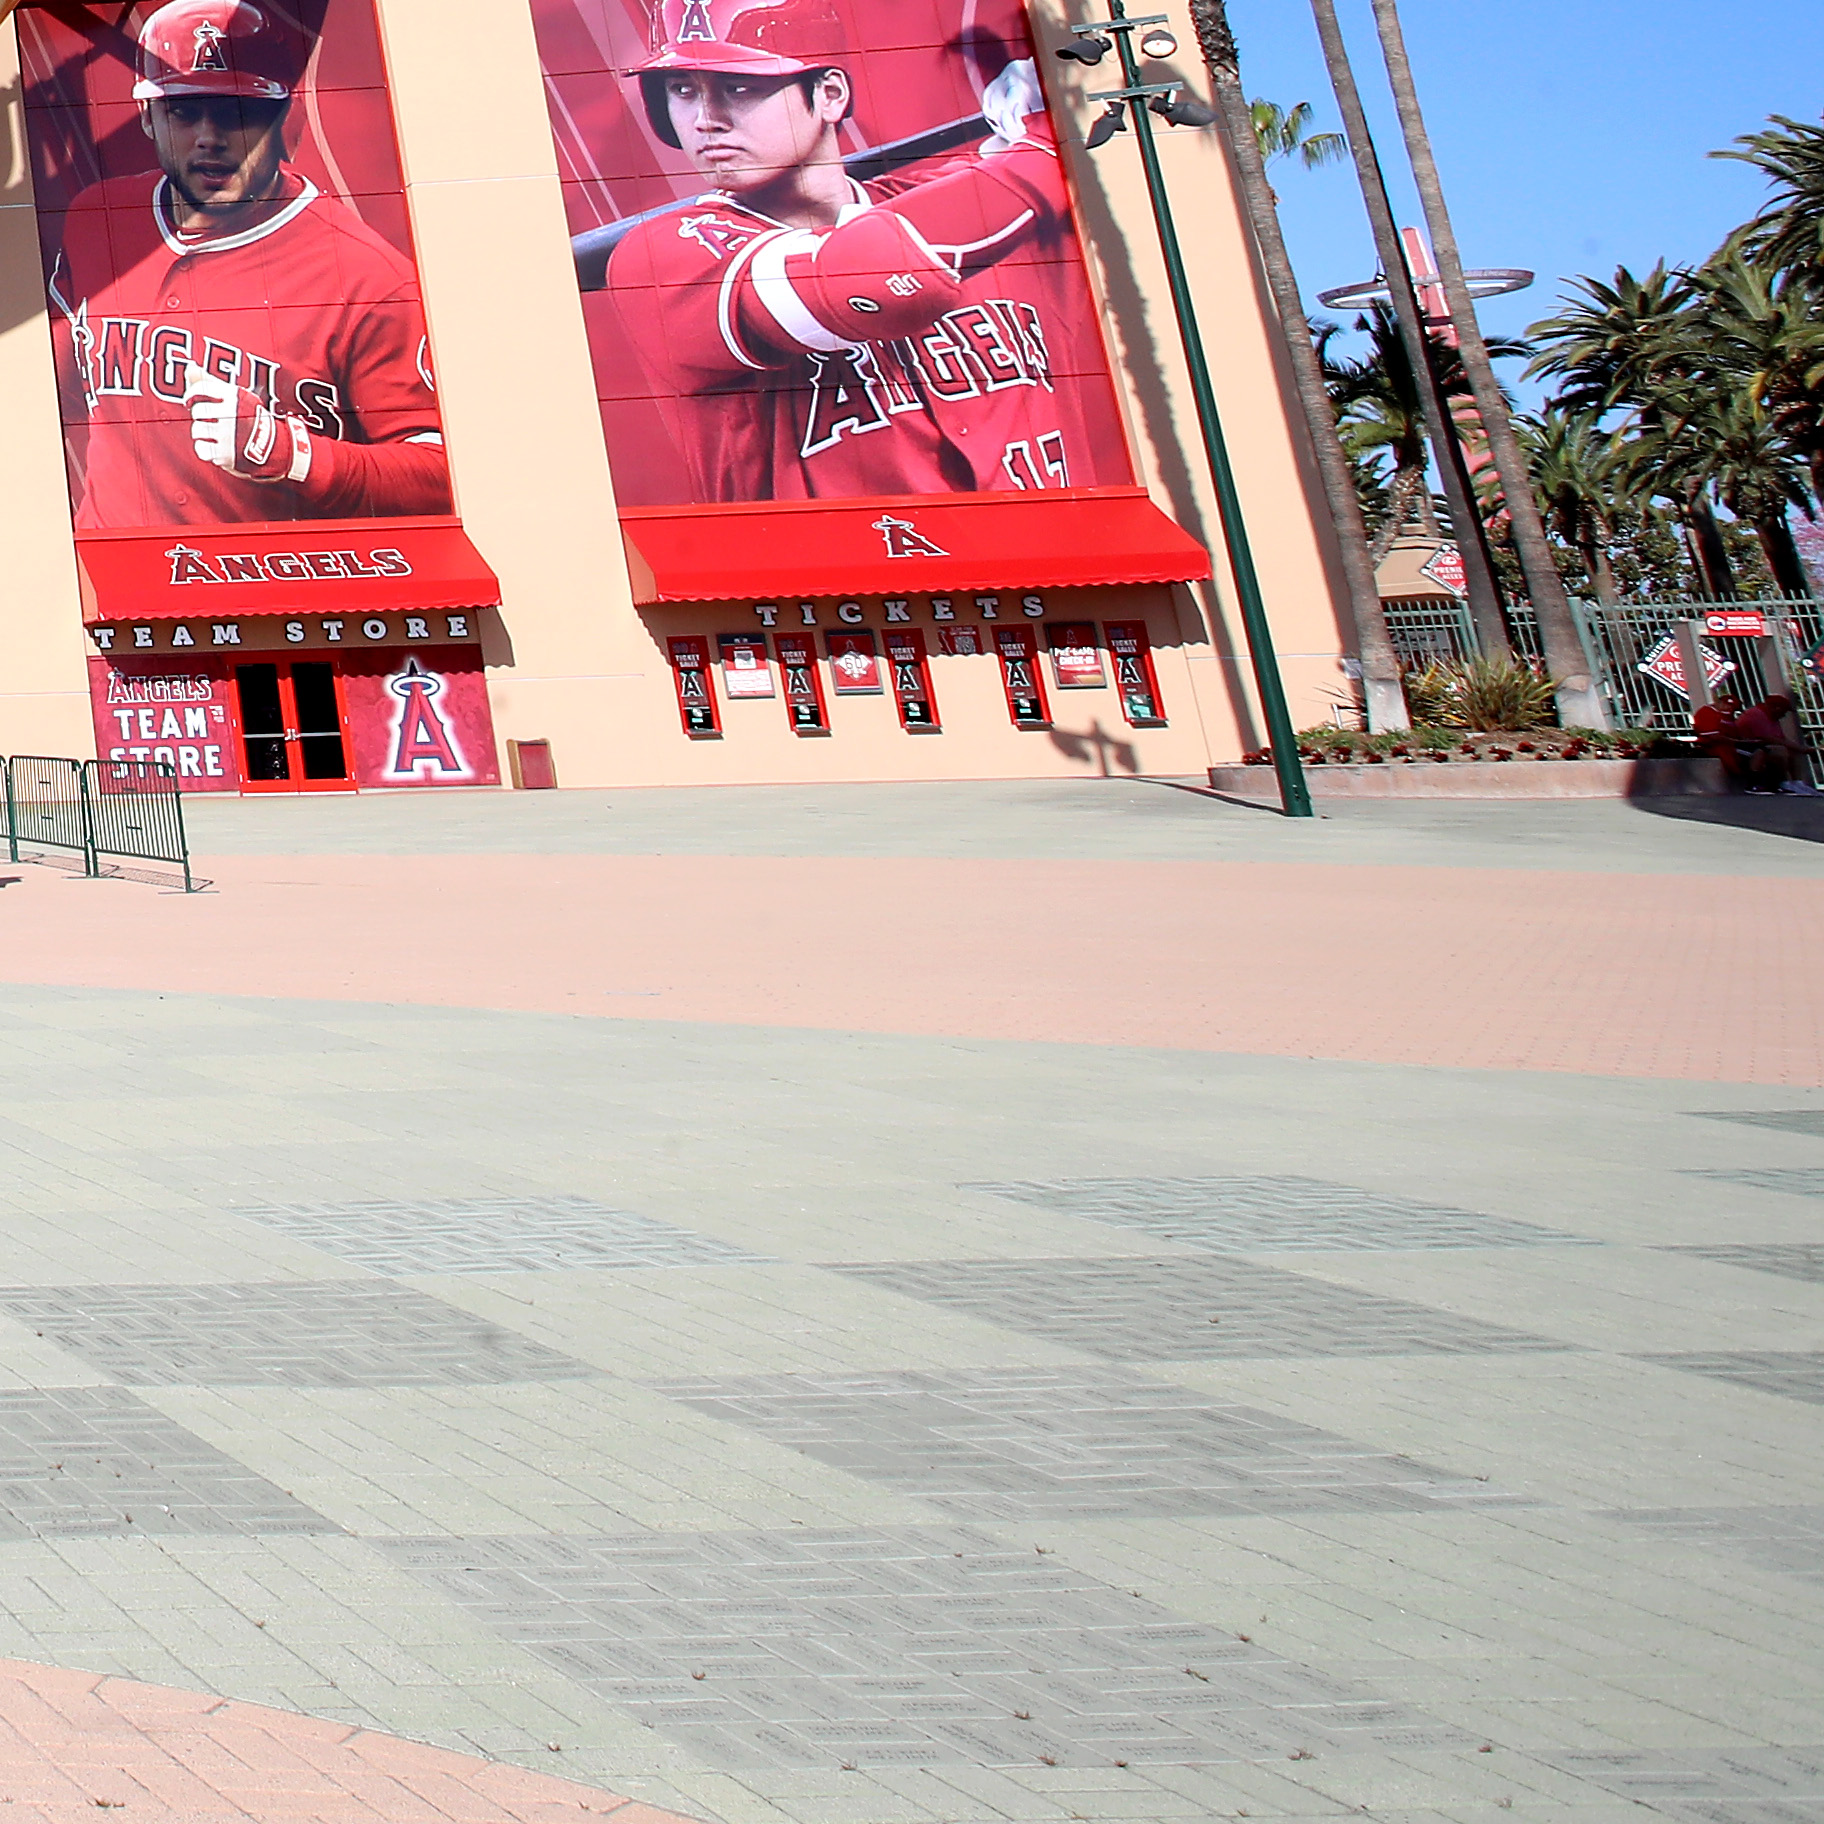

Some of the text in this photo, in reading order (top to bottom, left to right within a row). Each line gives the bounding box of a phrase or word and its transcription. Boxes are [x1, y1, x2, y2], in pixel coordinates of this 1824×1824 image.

[871, 514, 952, 559] A
[164, 543, 414, 586] ANGELS
[755, 594, 1044, 627] TICKETS
[94, 614, 470, 650] TEAM STORE
[106, 666, 213, 704] ANGELS
[112, 706, 209, 740] TEAM
[385, 656, 468, 776] A
[111, 744, 224, 778] STORE
